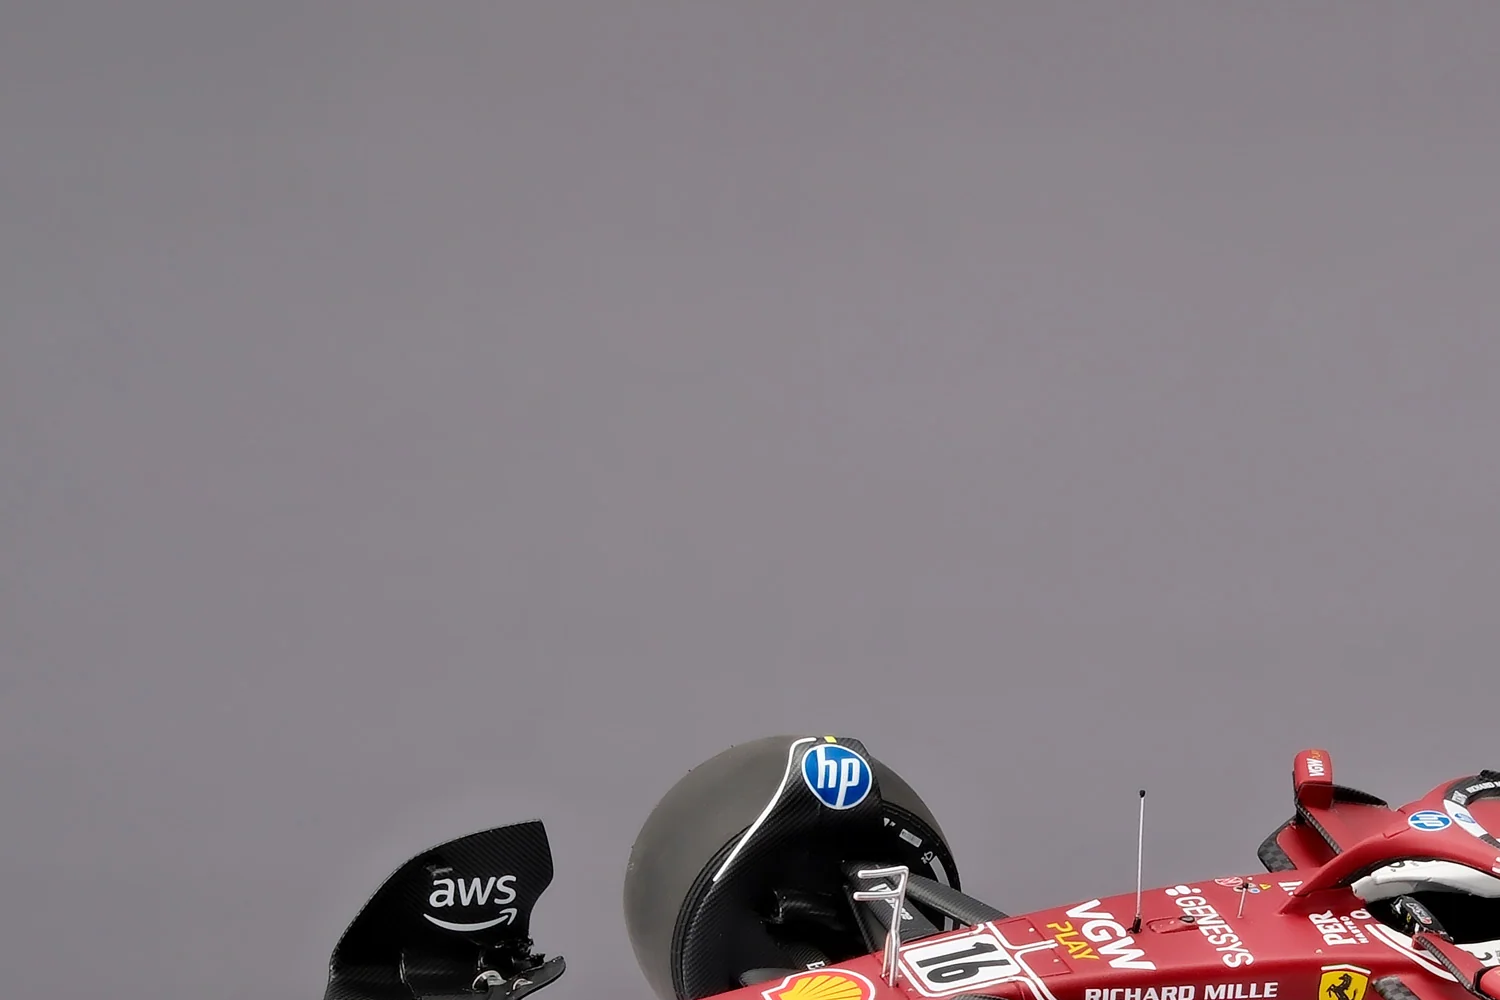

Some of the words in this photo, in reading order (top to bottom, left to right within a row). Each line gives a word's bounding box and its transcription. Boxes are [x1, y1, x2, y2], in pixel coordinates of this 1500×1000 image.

[816, 746, 861, 808] hp
[429, 874, 518, 908] aws
[1047, 920, 1100, 960] PLAY
[1066, 899, 1157, 970] VGW
[1175, 895, 1255, 968] GENESYS
[916, 941, 1012, 984] 16
[1204, 982, 1279, 1000] MILLE
